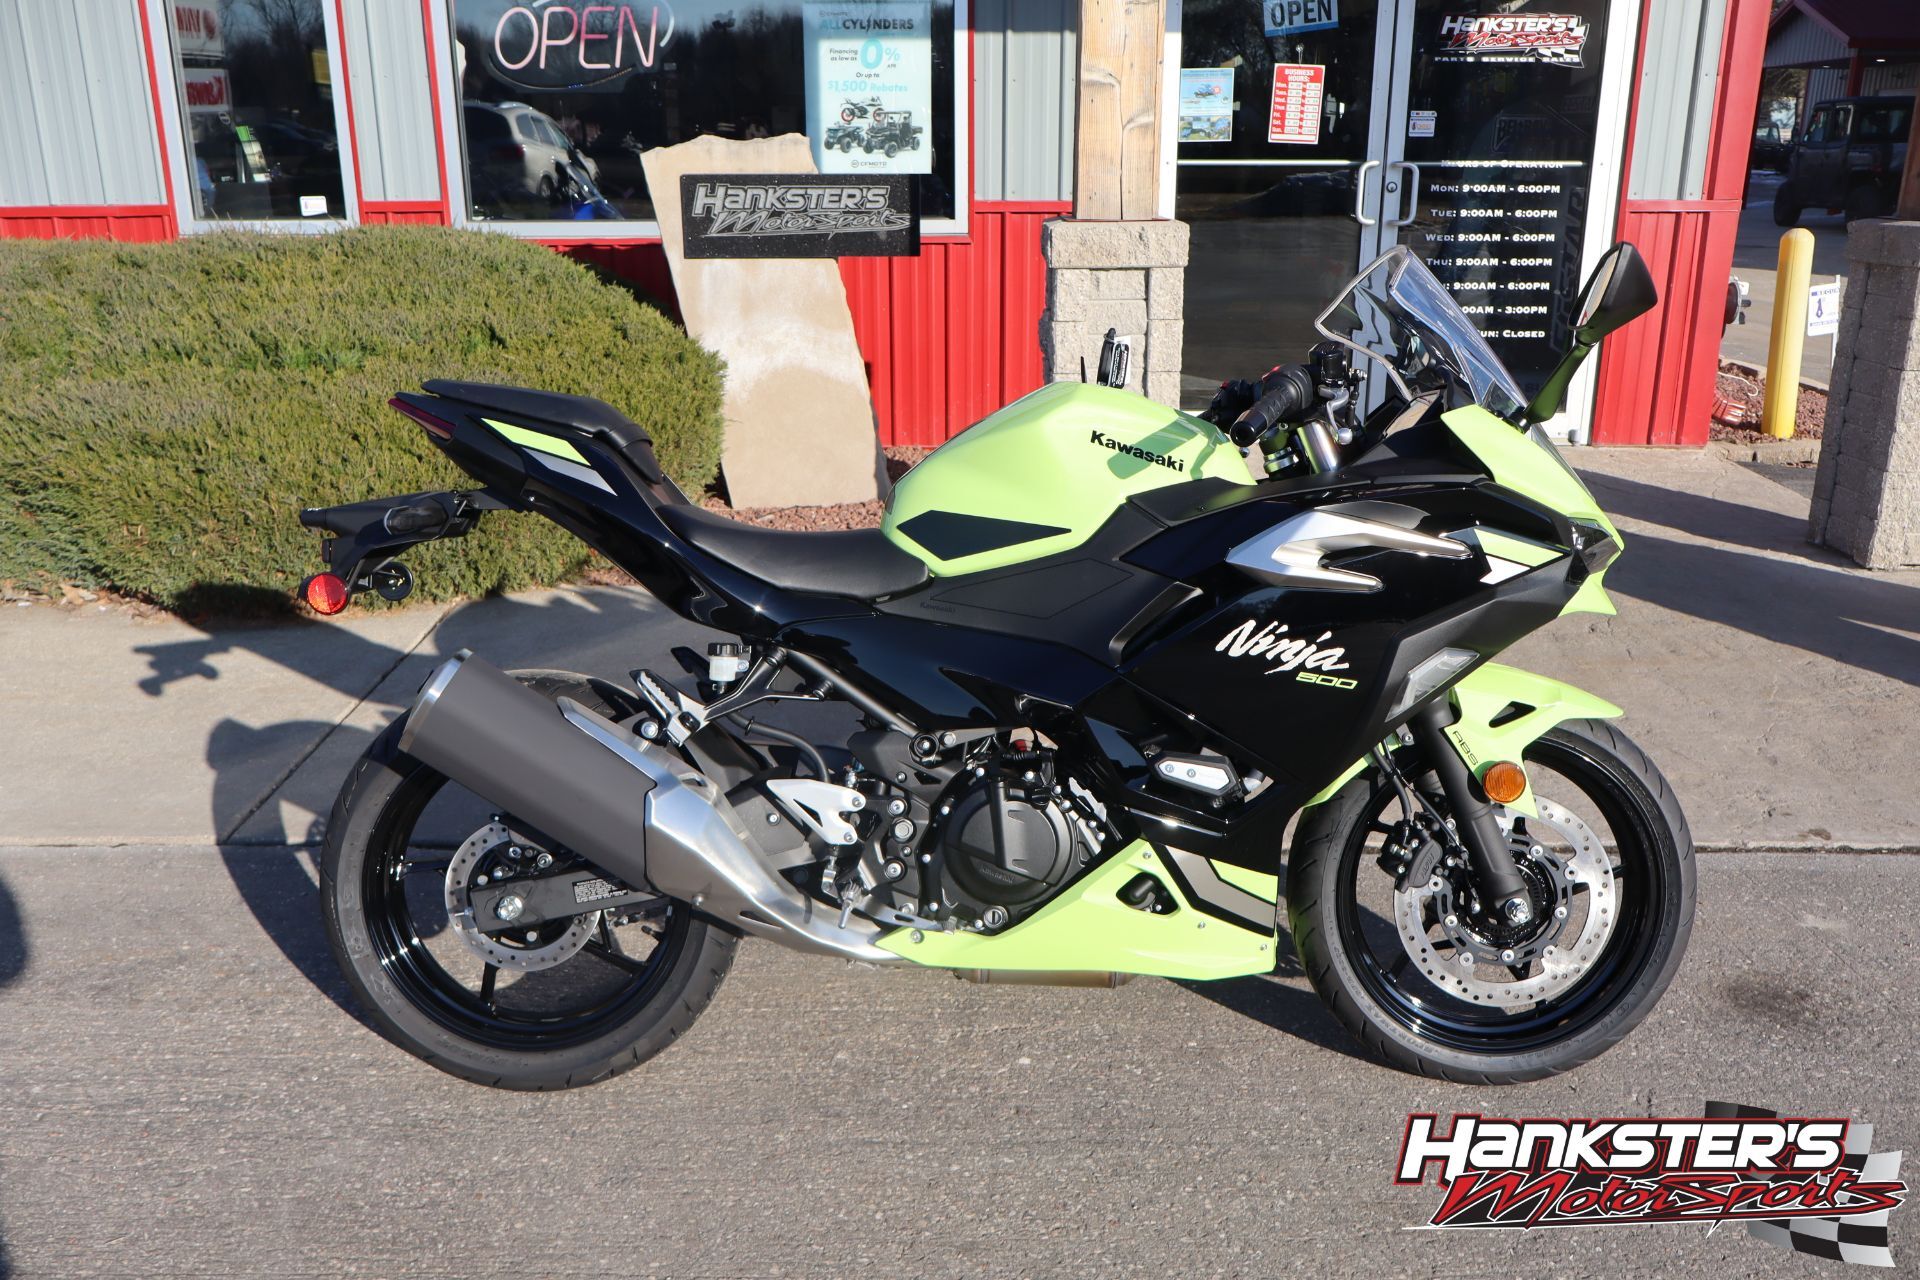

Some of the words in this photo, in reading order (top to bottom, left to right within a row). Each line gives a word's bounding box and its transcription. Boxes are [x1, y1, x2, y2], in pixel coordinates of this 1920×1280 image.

[1271, 0, 1332, 27] OPEN
[495, 6, 658, 70] OPEN
[829, 48, 858, 56] Financing
[827, 80, 867, 92] $1,500
[871, 82, 908, 92] Rebates
[1517, 185, 1561, 193] 6:00PM
[1460, 209, 1503, 217] 9:00AM
[1515, 209, 1557, 218] 6:00PM
[1458, 234, 1501, 242] 9:00AM
[1512, 234, 1555, 242] 6:00PM
[1456, 258, 1498, 266] 9:00AM
[1510, 258, 1553, 266] 6:00PM
[1453, 282, 1496, 290] 9:00AM
[1507, 282, 1550, 290] 6:00PM
[1461, 306, 1494, 314] 00AM
[1505, 306, 1547, 314] 3:00PM
[1479, 330, 1499, 338] UN:
[1090, 430, 1184, 472] Kawasaki
[1215, 619, 1350, 675] Ninja
[1296, 671, 1358, 690] 500
[1453, 730, 1479, 766] ABS
